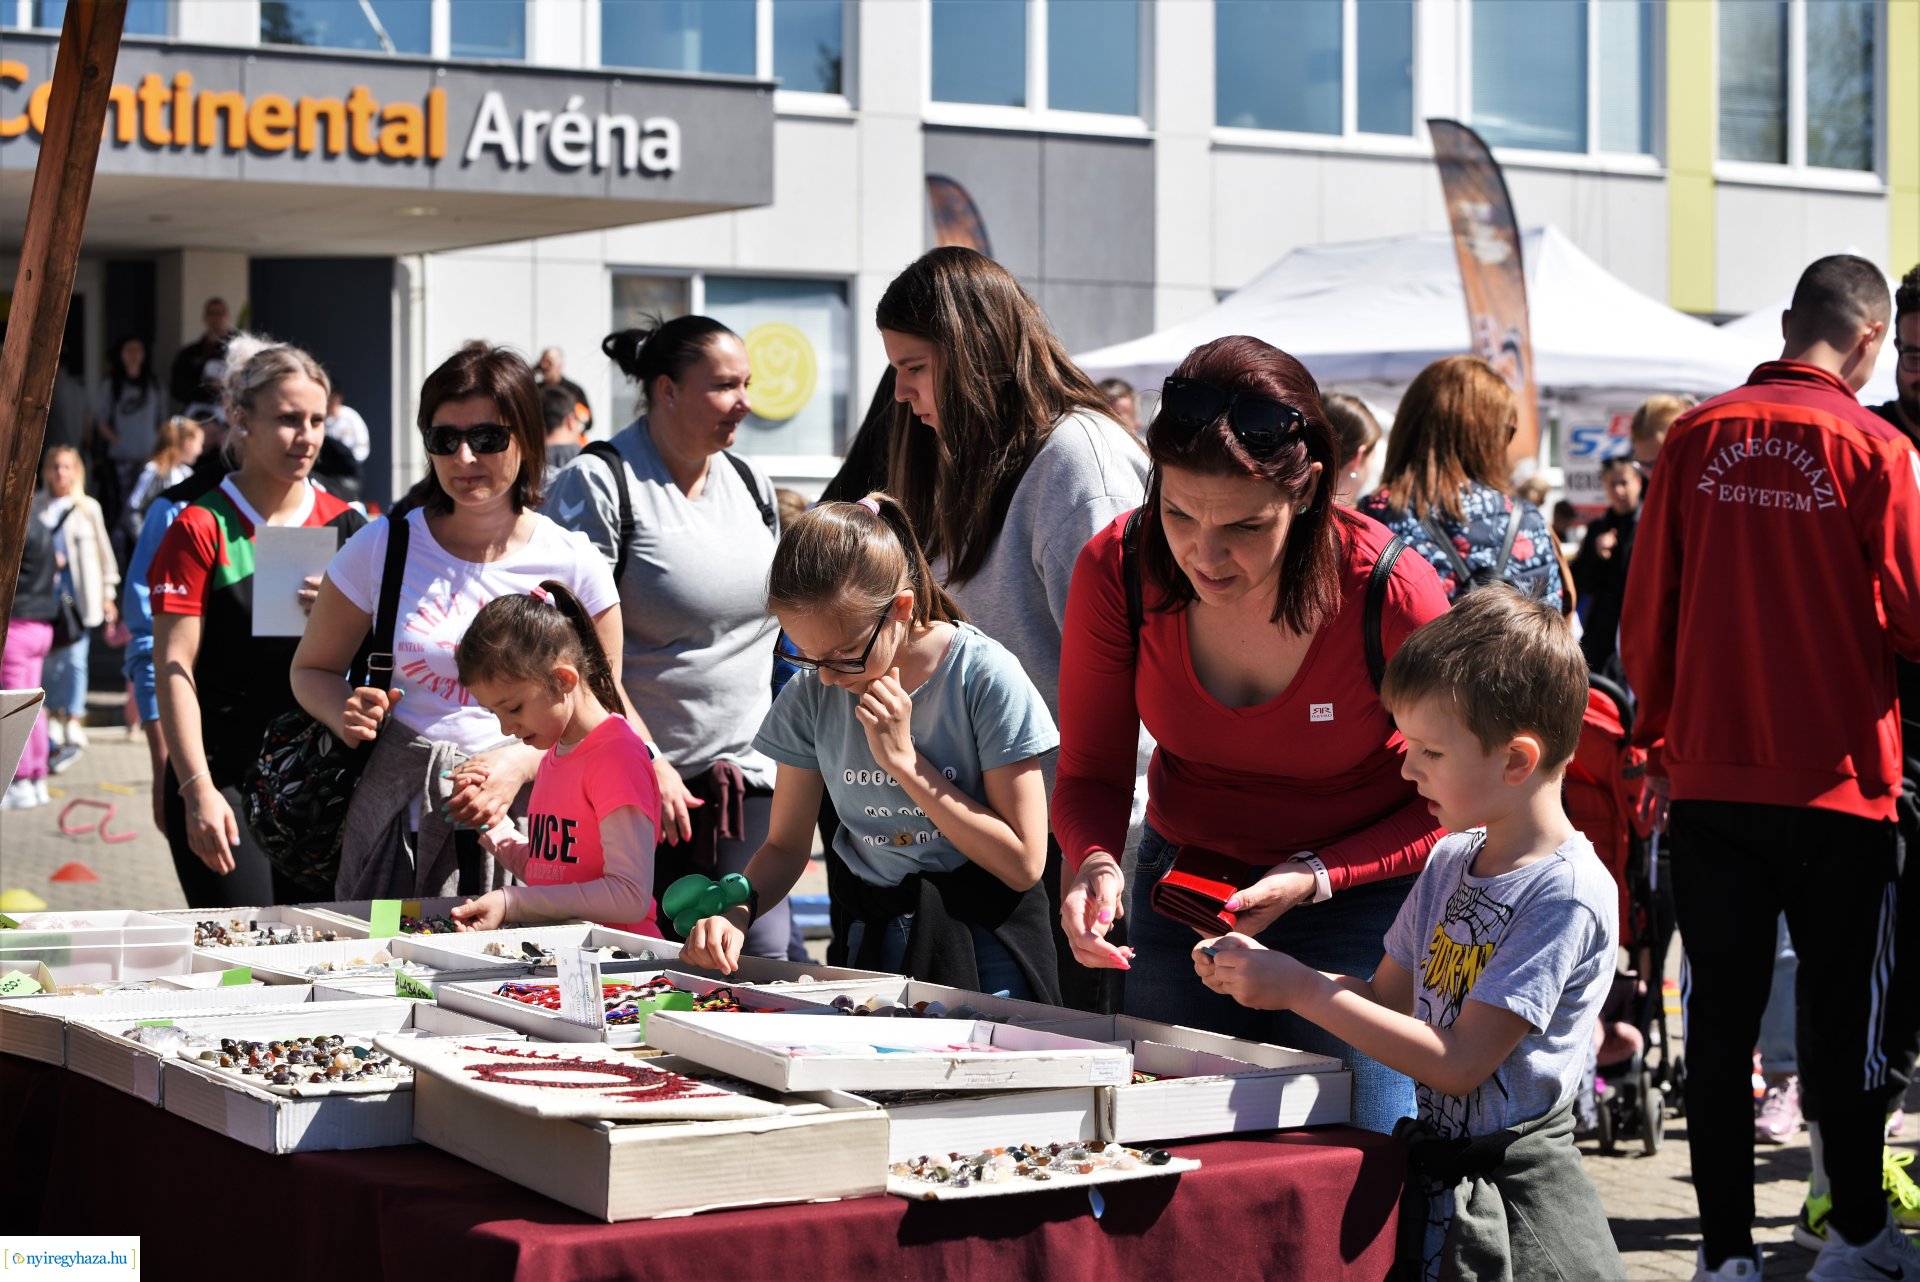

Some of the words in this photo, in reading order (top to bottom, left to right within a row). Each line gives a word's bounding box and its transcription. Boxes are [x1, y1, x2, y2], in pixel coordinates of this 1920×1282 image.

[466, 90, 681, 172] Aréna
[1697, 437, 1837, 510] NYÍREGYHÁZI
[1719, 484, 1813, 513] EGYETEM
